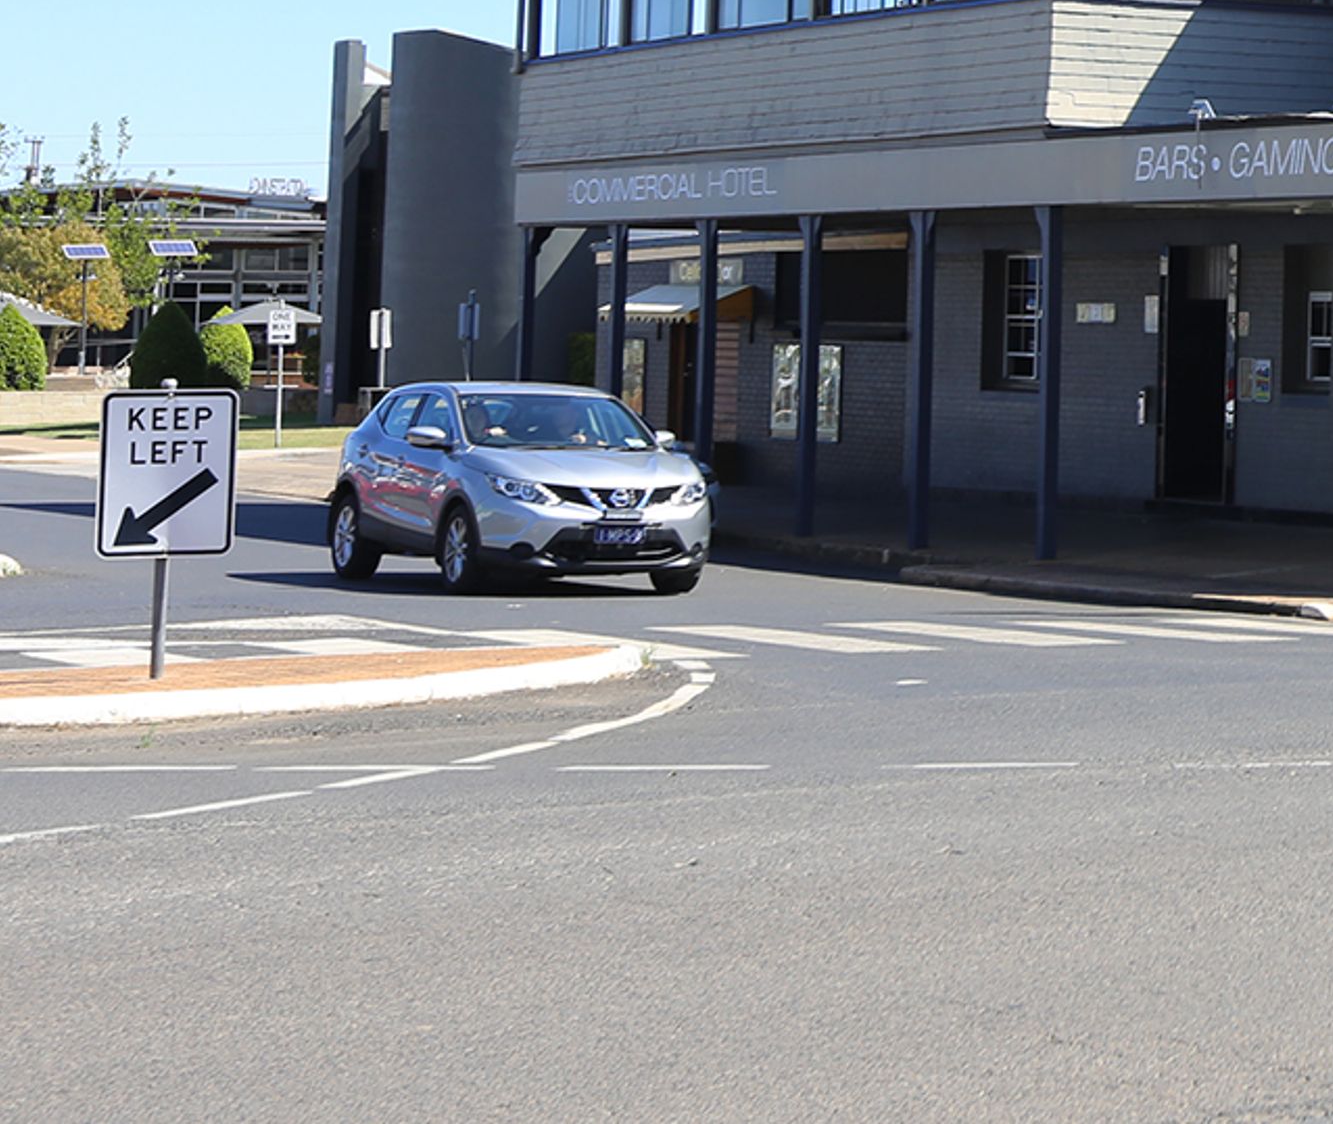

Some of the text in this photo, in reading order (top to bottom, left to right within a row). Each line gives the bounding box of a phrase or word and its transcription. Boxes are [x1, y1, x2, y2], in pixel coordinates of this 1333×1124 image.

[1135, 144, 1207, 182] BARS
[573, 173, 702, 204] COMMERCIAL
[708, 167, 777, 198] HOTEL
[128, 406, 213, 431] KEEP
[130, 440, 208, 465] LEFT
